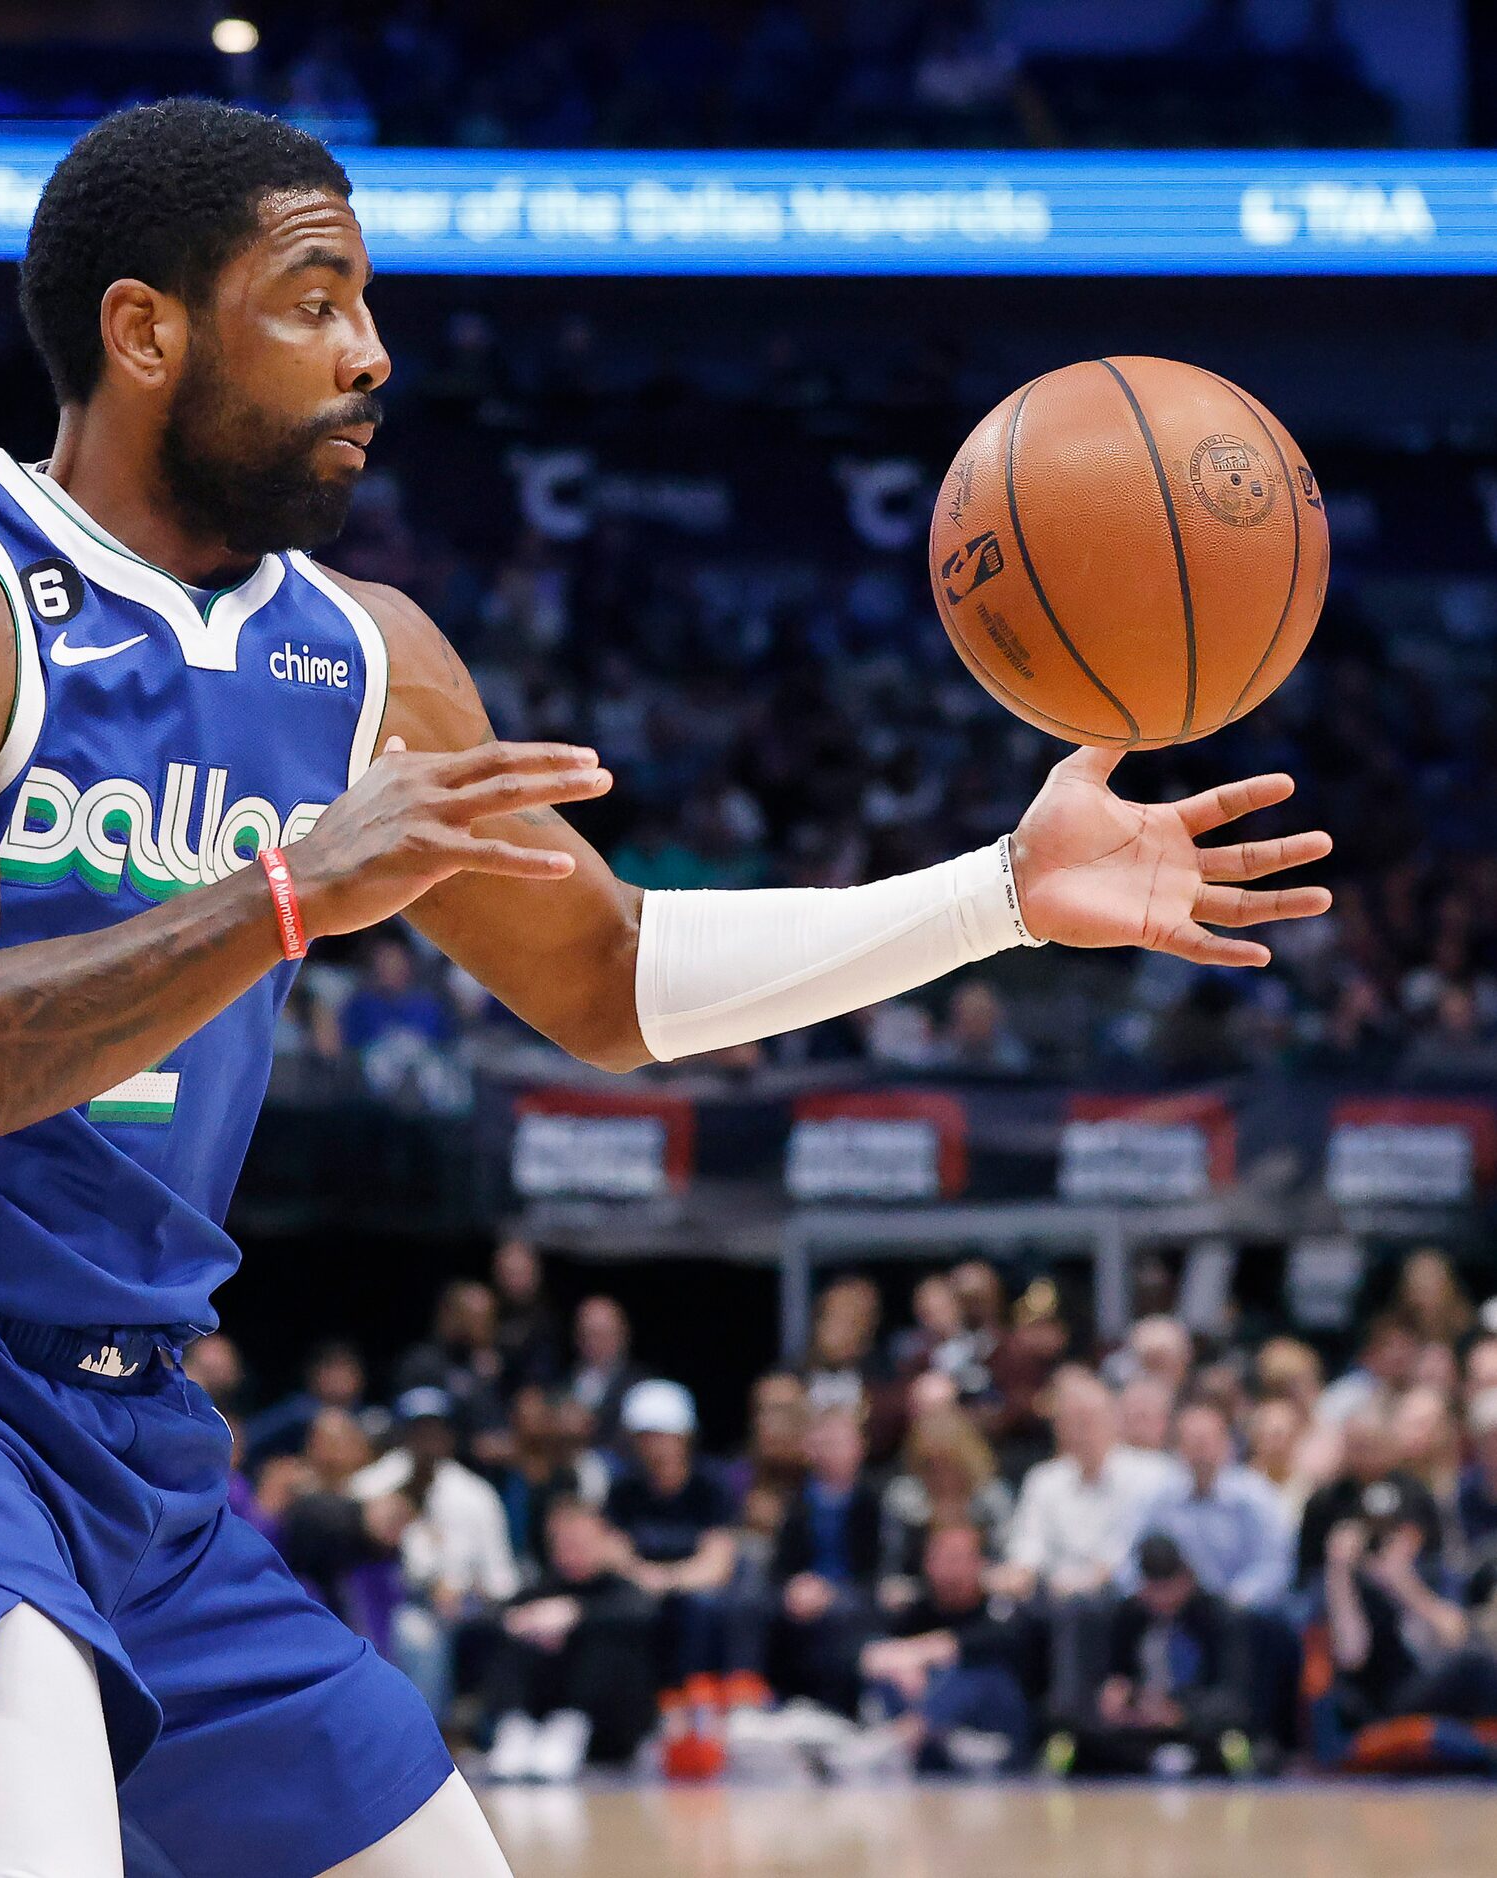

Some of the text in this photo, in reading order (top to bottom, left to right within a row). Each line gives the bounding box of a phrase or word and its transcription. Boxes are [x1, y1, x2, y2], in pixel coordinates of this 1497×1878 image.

[527, 178, 623, 243] the
[626, 177, 785, 244] Dallas
[28, 568, 71, 621] 6
[269, 642, 349, 688] chime
